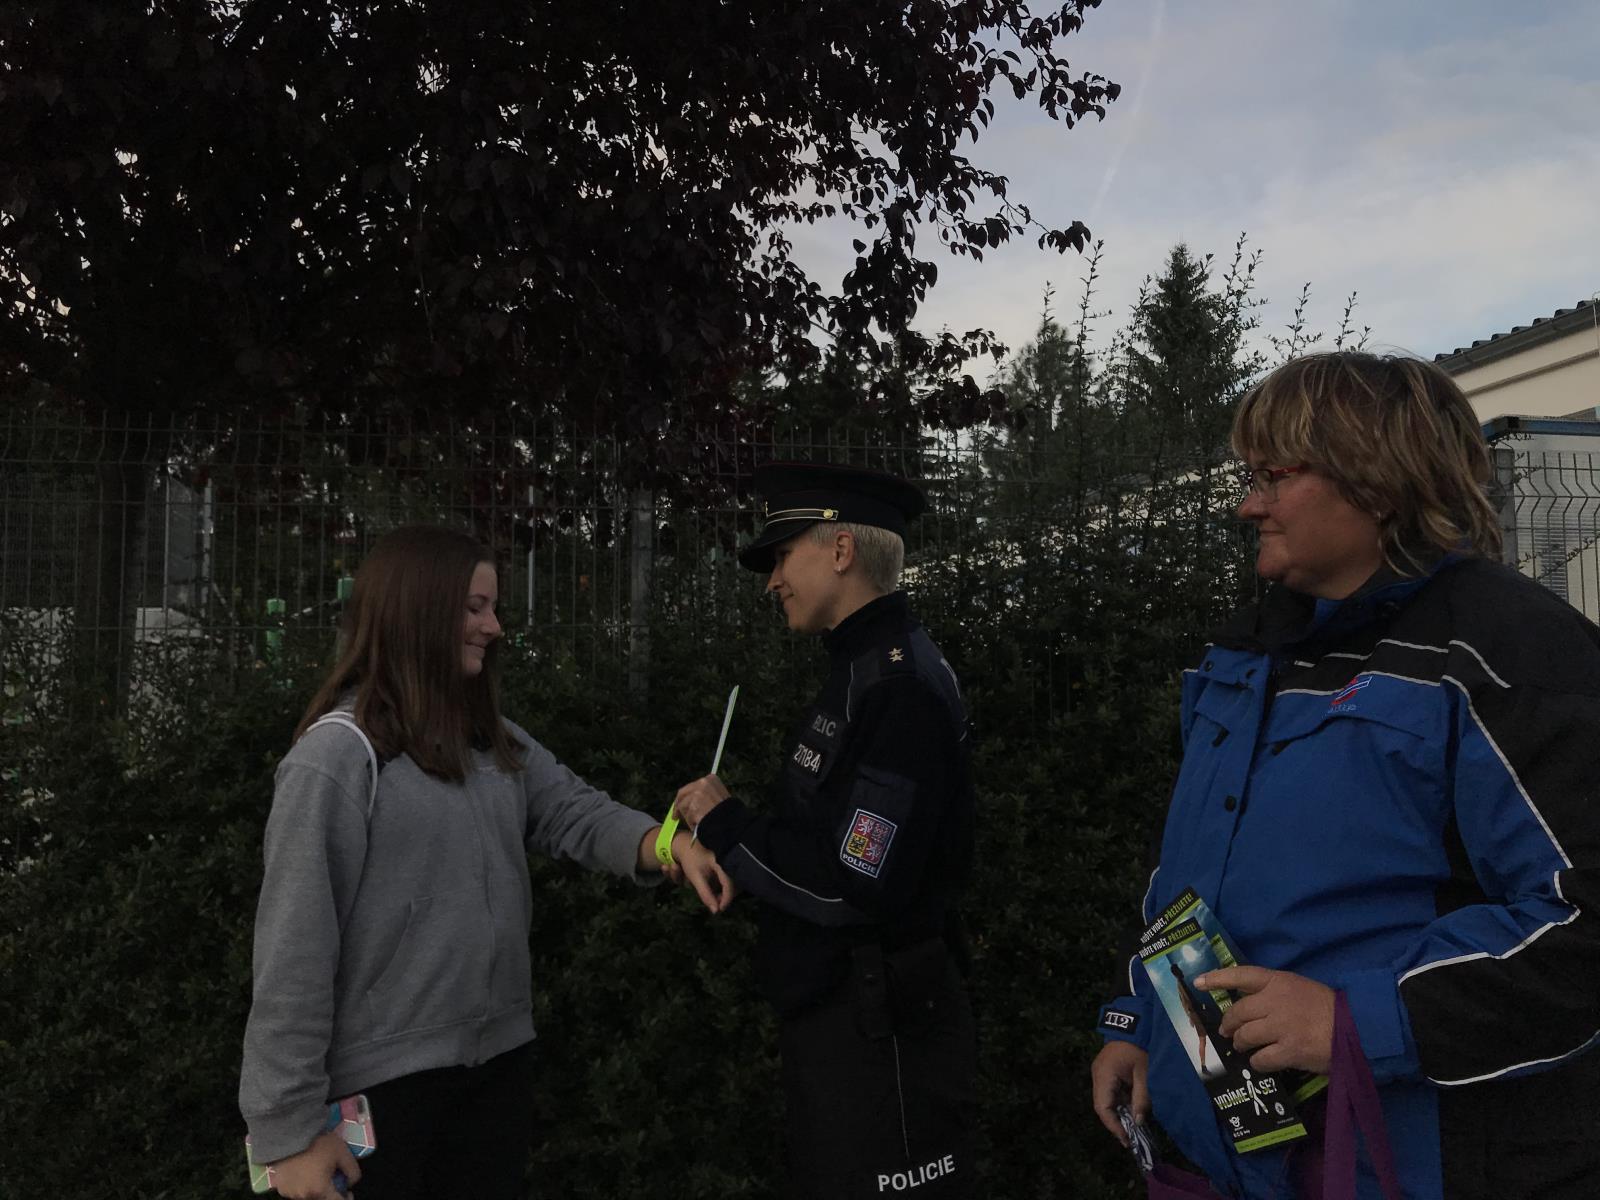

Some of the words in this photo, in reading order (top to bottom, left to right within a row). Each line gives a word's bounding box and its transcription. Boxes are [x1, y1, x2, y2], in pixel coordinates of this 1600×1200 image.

[842, 853, 877, 874] POLICIE
[1213, 1087, 1251, 1111] VIDÍME
[1258, 1077, 1278, 1095] SE?
[877, 1154, 956, 1192] POLICIE
